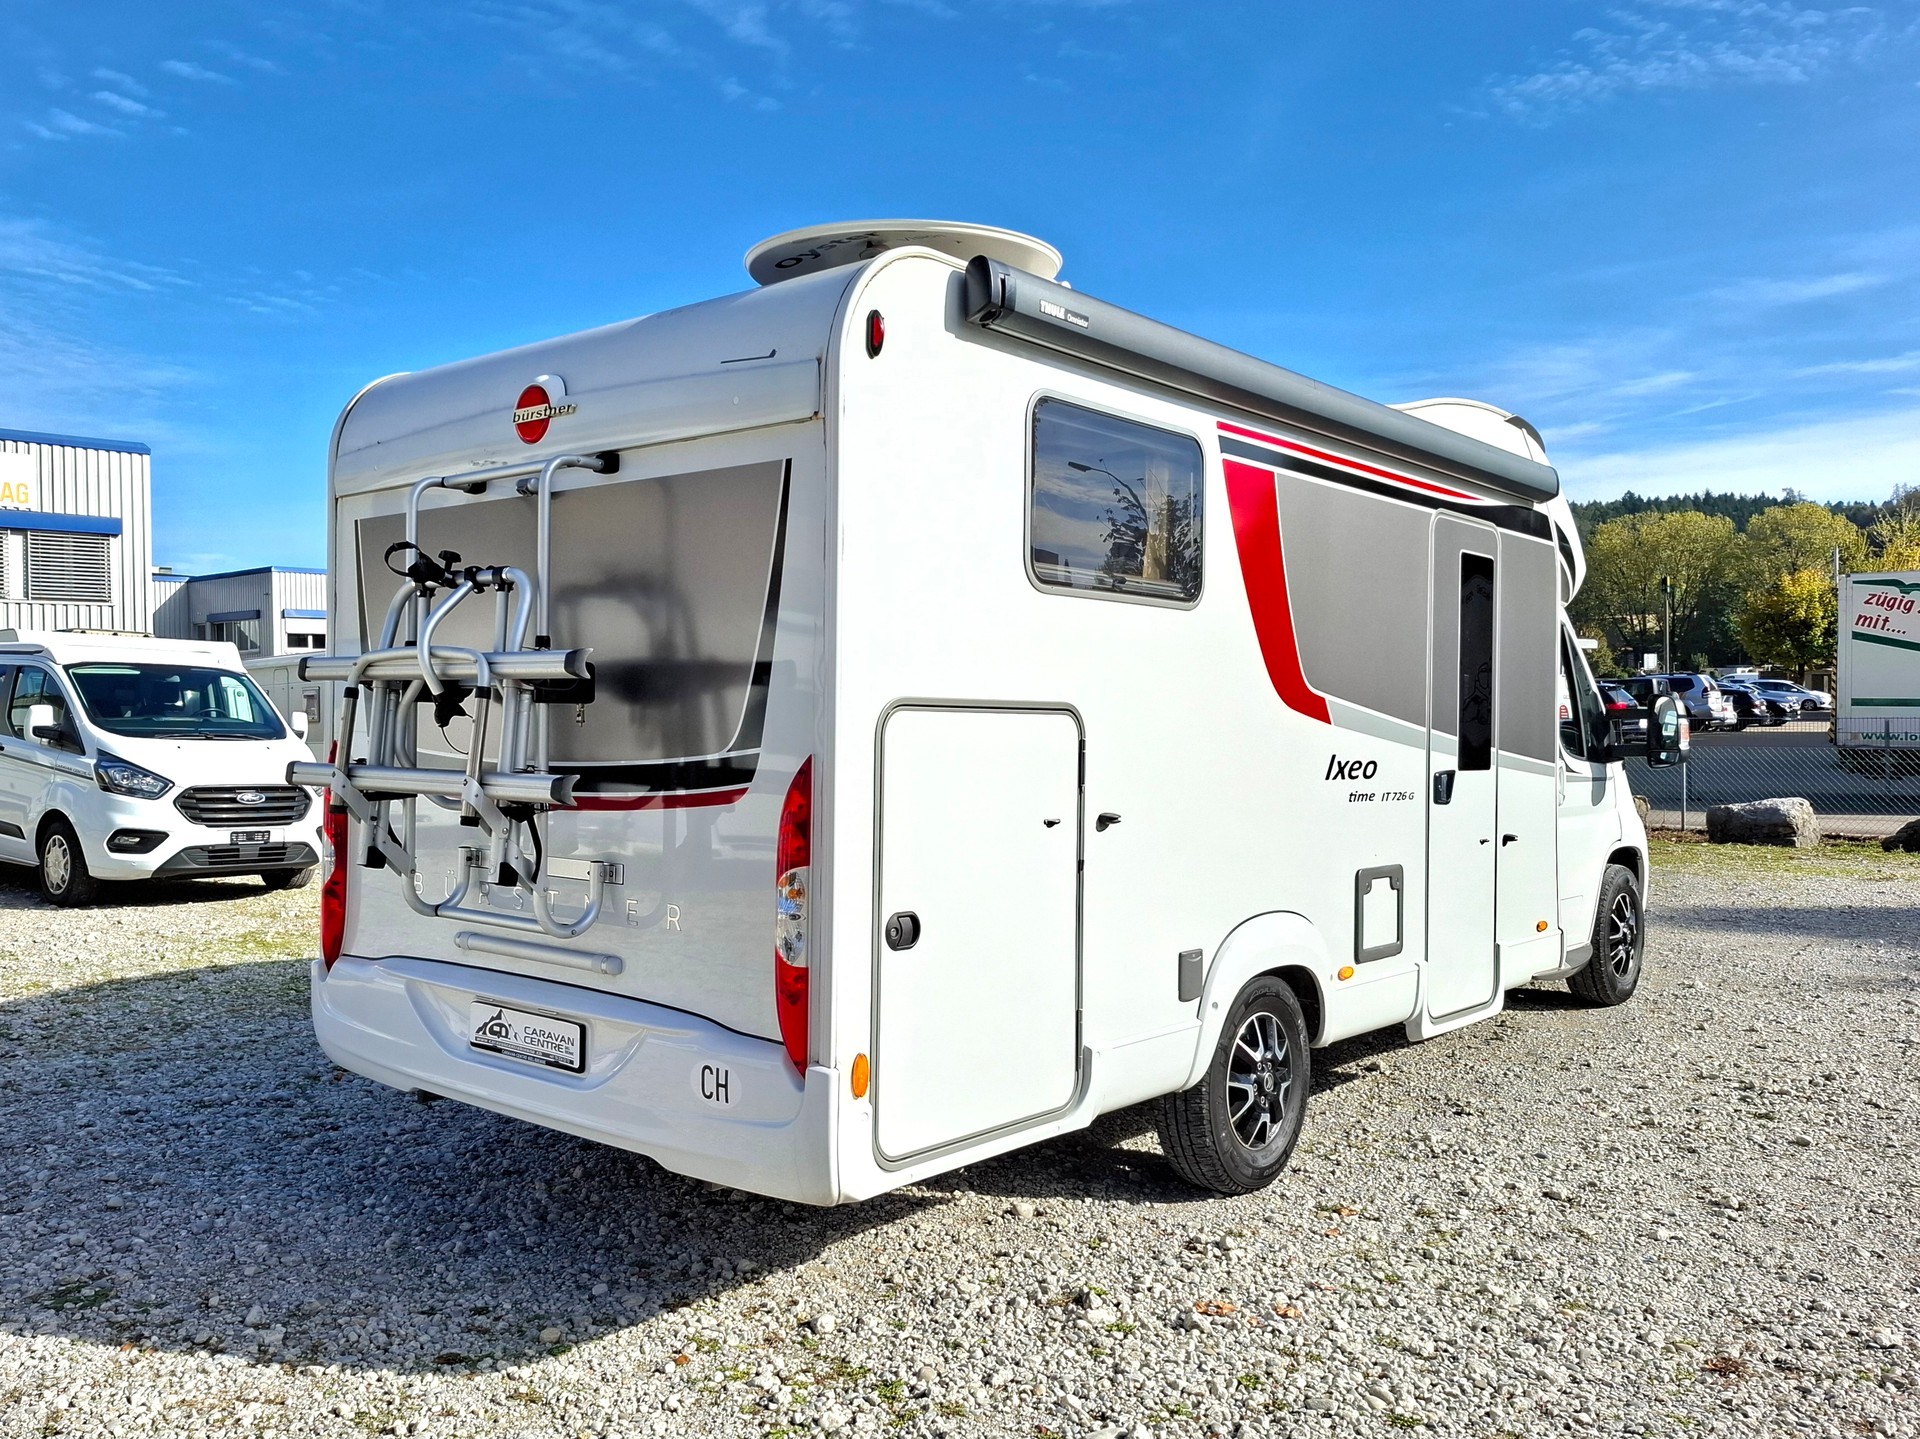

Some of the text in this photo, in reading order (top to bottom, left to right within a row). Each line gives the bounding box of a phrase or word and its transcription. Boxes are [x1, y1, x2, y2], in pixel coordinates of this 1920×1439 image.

[1040, 299, 1066, 320] THULE
[512, 404, 576, 424] bürstner
[0, 481, 29, 504] AG
[1863, 591, 1916, 615] zügig
[1861, 731, 1920, 741] www.lo
[1325, 754, 1378, 781] Ixeo
[1348, 790, 1376, 803] time
[1408, 791, 1415, 801] G
[413, 870, 682, 932] BÜRSTER
[523, 1026, 575, 1047] CARAVAN
[523, 1035, 564, 1054] CENTRE
[701, 1064, 729, 1104] CH
